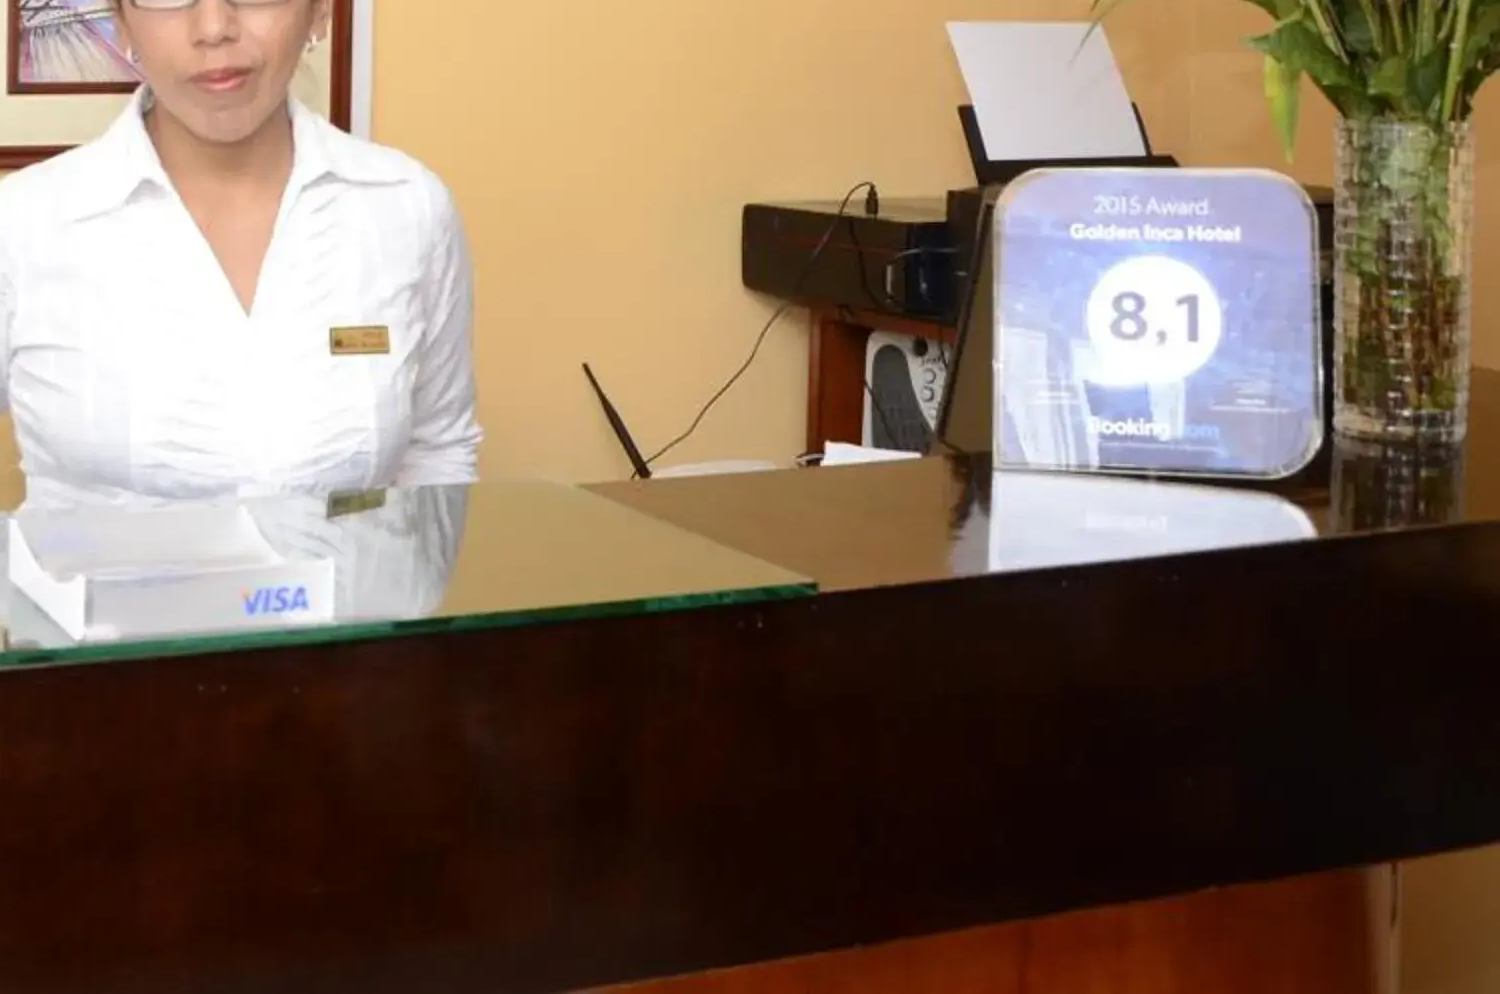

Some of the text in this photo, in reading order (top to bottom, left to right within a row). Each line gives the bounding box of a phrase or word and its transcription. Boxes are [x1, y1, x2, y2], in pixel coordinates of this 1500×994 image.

[1093, 194, 1209, 217] 2015 Award
[1069, 222, 1242, 243] Golden Inca Hotel
[1109, 290, 1199, 345] 8,1
[241, 586, 309, 615] VISA
